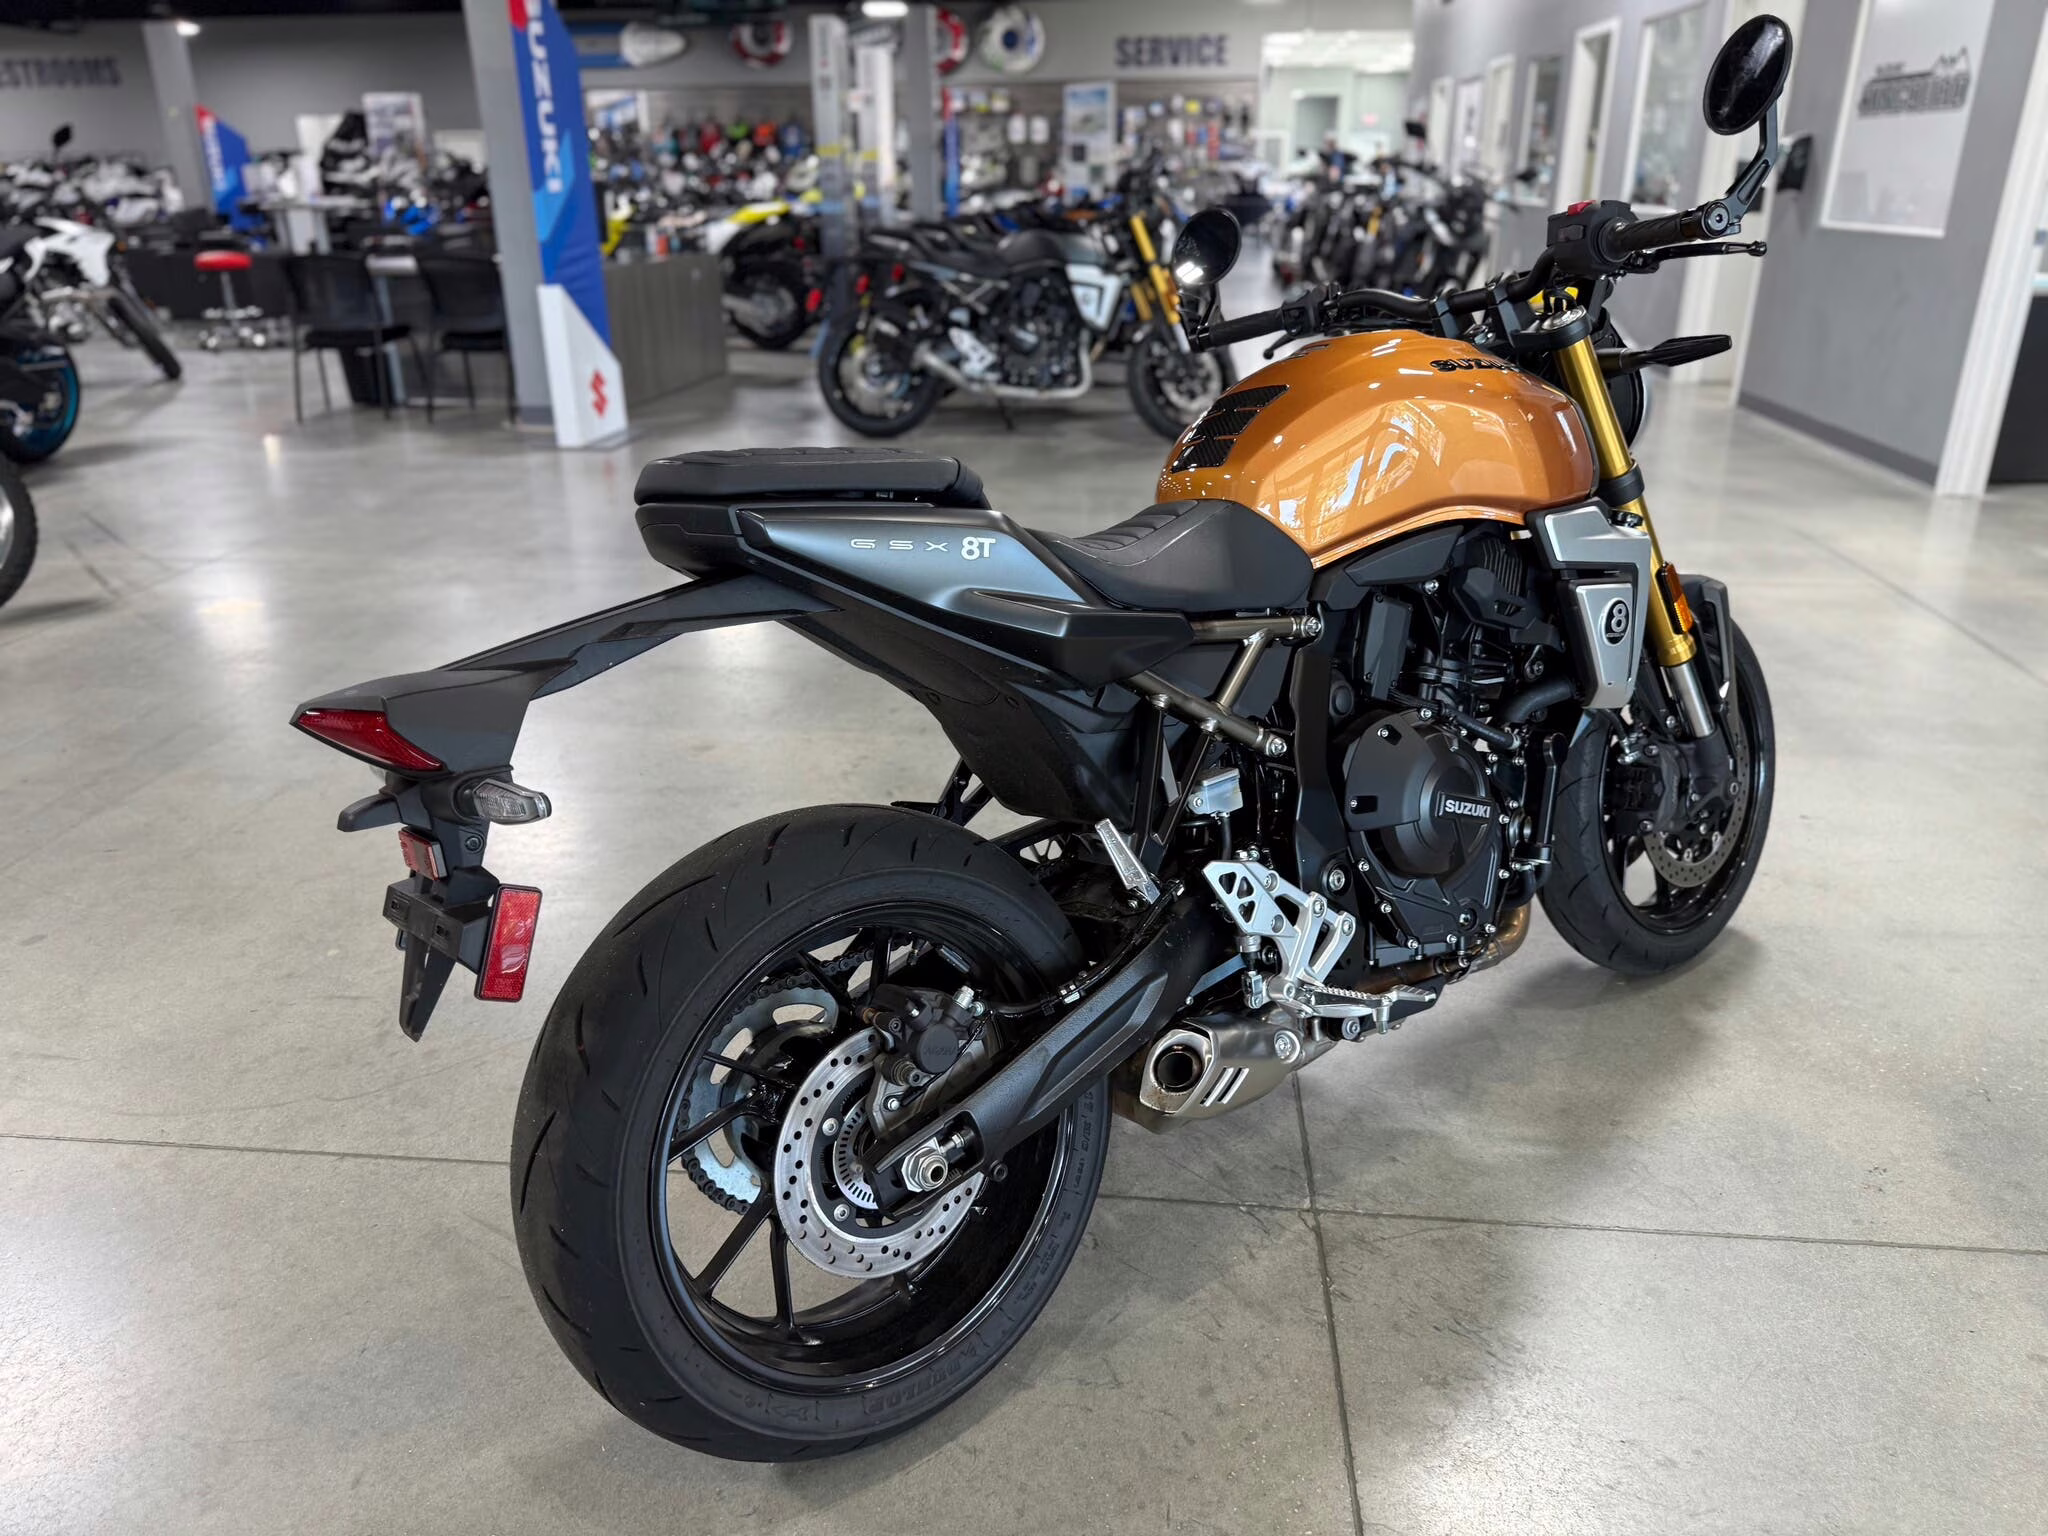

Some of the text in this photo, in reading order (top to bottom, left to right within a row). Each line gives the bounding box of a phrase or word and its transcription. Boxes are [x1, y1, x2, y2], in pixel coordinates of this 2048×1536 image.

[1115, 34, 1229, 68] SERVICE
[850, 536, 997, 561] GSX 8T
[1610, 603, 1628, 633] 8
[1444, 799, 1492, 819] SUZUKI
